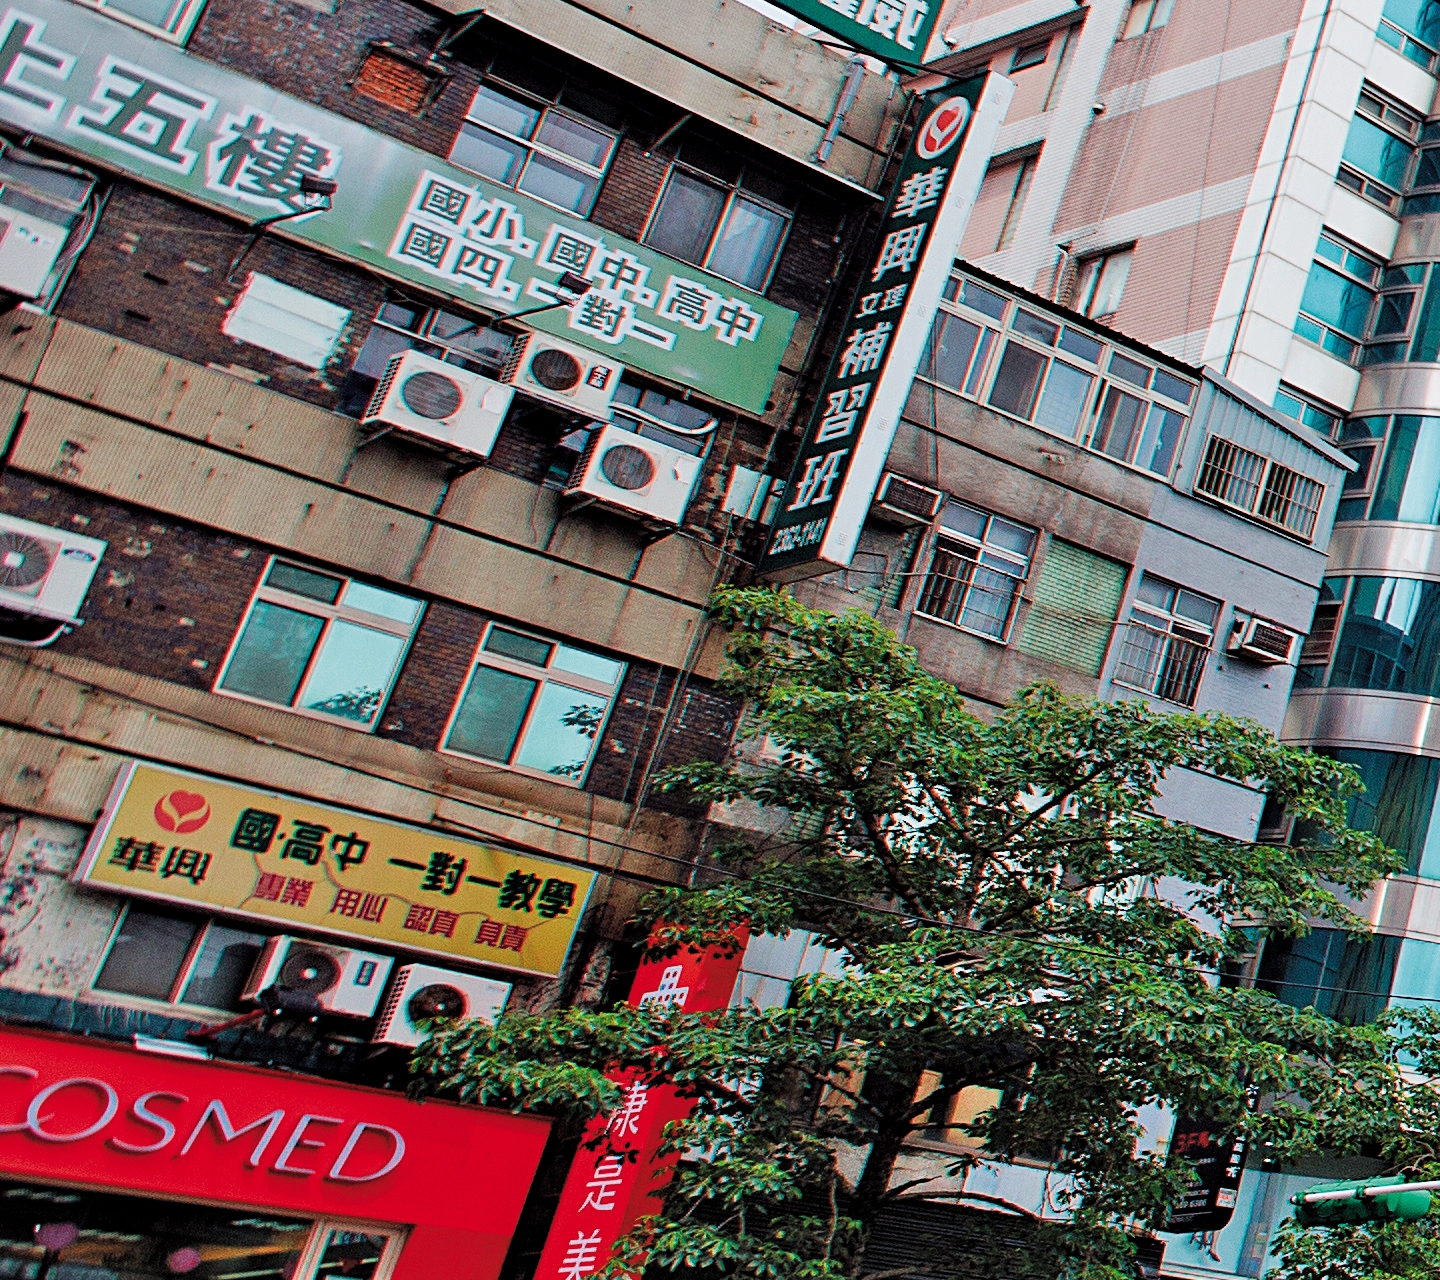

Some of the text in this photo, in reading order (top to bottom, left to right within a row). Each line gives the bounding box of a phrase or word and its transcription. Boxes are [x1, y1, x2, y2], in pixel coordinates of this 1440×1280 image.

[108, 835, 212, 886] 華興
[388, 851, 579, 920] 一對一教學
[253, 871, 530, 953] 專業 用心 認真 負責
